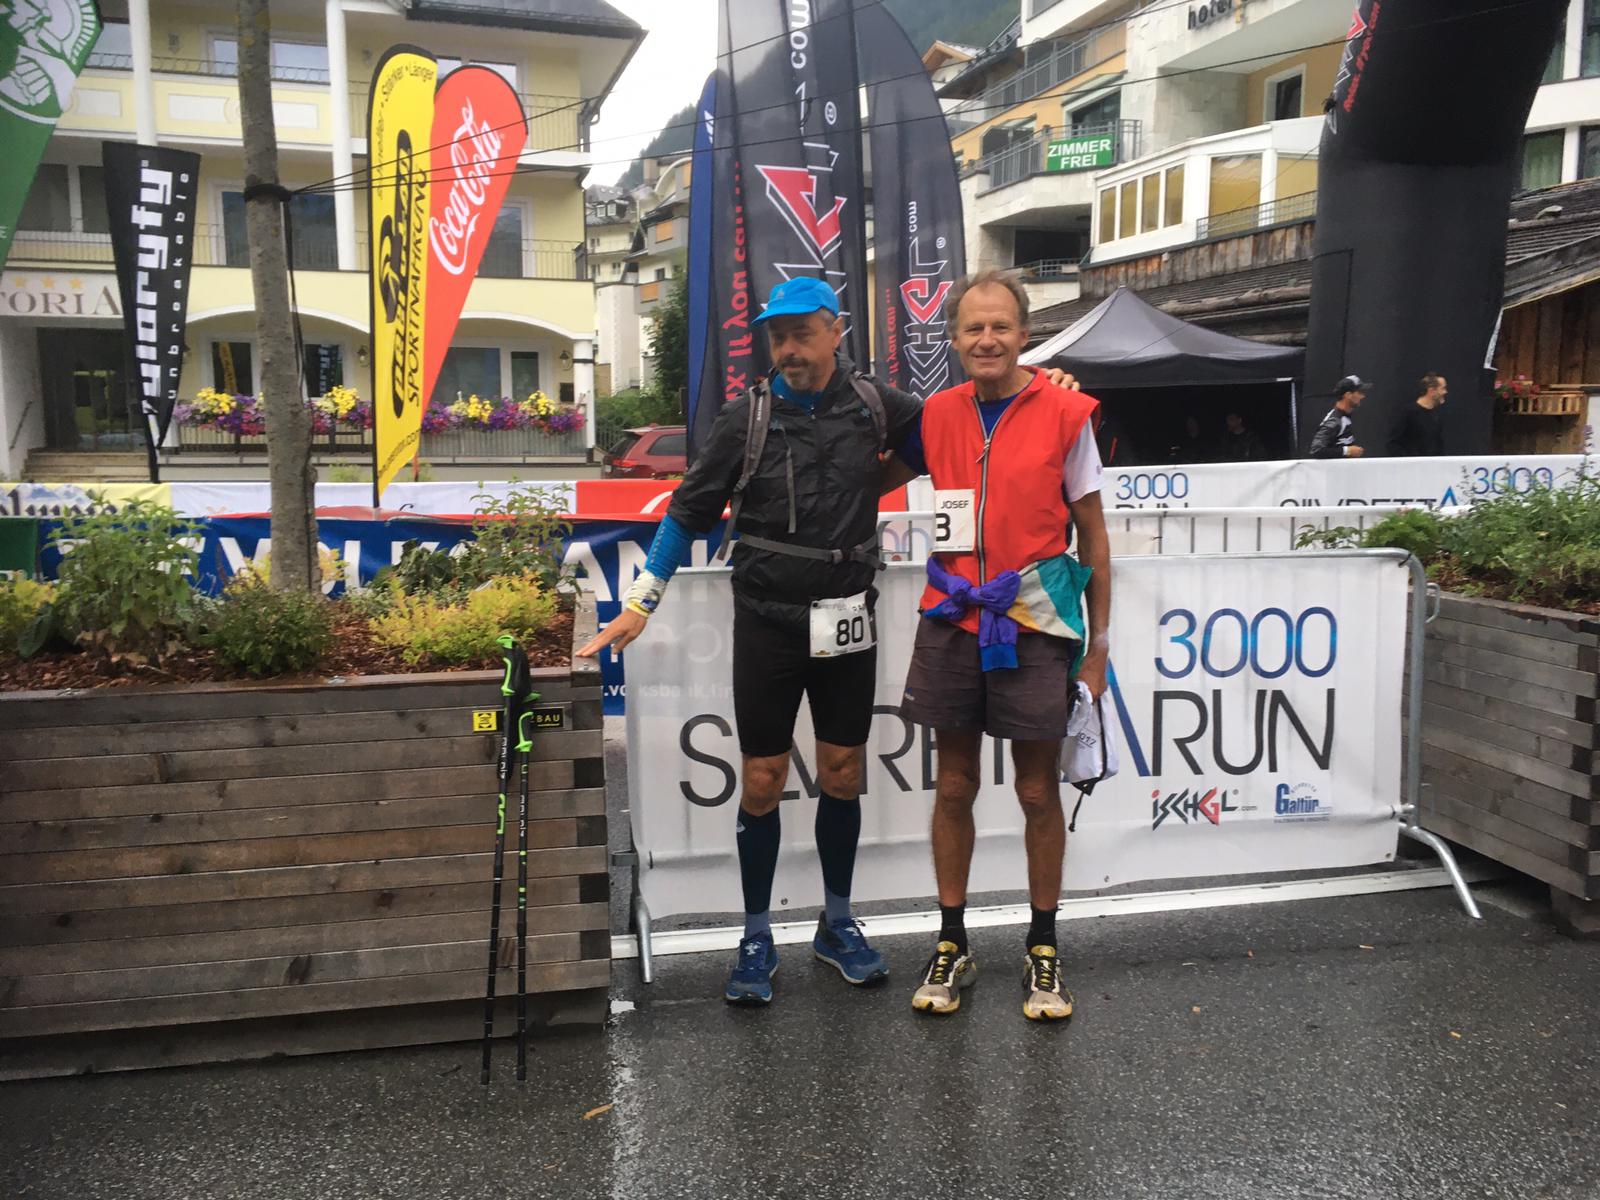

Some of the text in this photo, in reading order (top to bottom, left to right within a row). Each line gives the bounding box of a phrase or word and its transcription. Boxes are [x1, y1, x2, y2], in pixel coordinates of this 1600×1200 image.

[1047, 139, 1112, 157] ZIMMER
[1060, 154, 1098, 169] FREI
[0, 286, 121, 316] ORIA
[167, 172, 190, 400] unbreakable
[1115, 472, 1189, 500] 3000
[1472, 466, 1554, 496] 3000
[940, 500, 969, 510] JOSEF
[836, 616, 865, 647] 80
[1154, 606, 1338, 679] 3000
[1152, 688, 1336, 777] RUN
